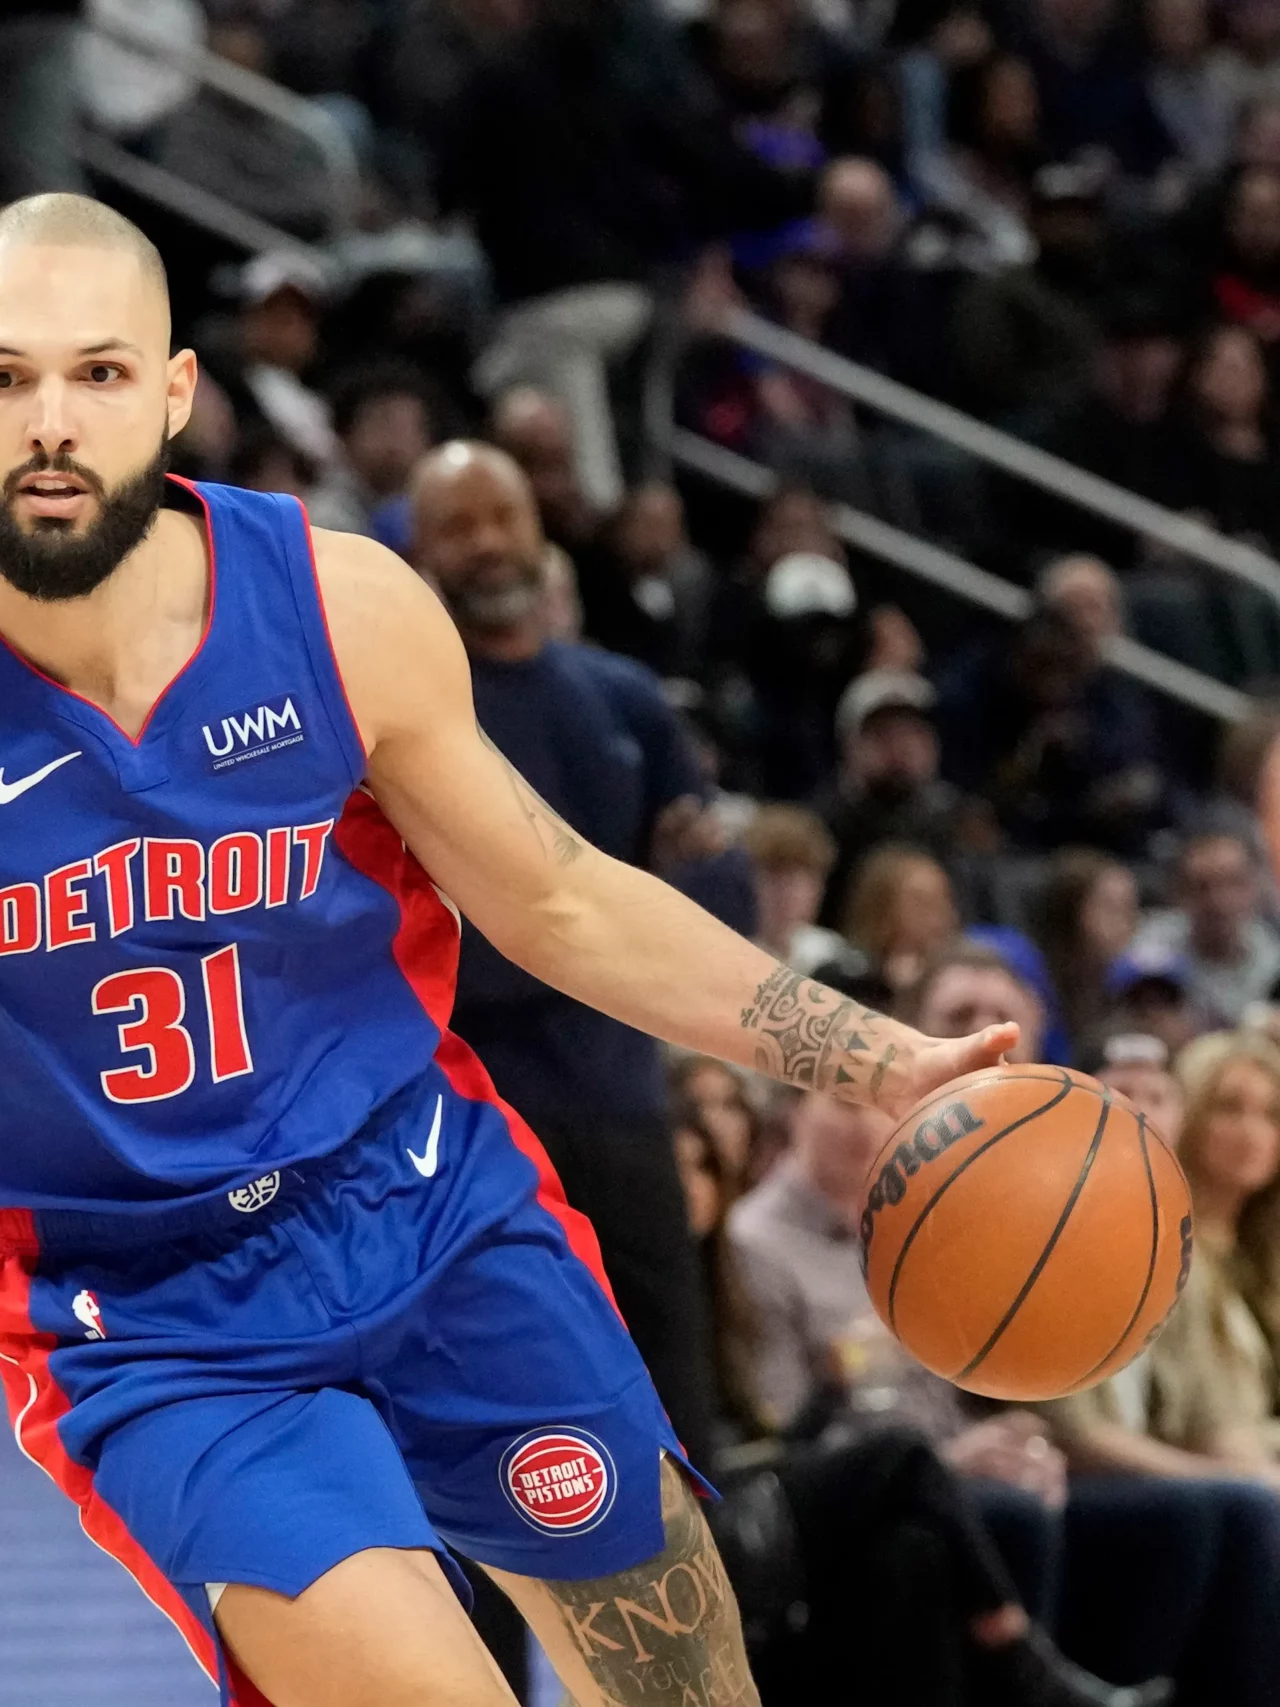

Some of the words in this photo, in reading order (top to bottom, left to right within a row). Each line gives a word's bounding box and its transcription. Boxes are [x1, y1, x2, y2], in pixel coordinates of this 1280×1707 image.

[202, 697, 301, 756] UWM
[213, 758, 236, 771] UNITED
[235, 745, 271, 763] WHOLESALE
[271, 734, 305, 751] MORTGAGE
[91, 942, 254, 1105] 31
[518, 1457, 588, 1489] DETROIT
[524, 1473, 595, 1505] PISTONS
